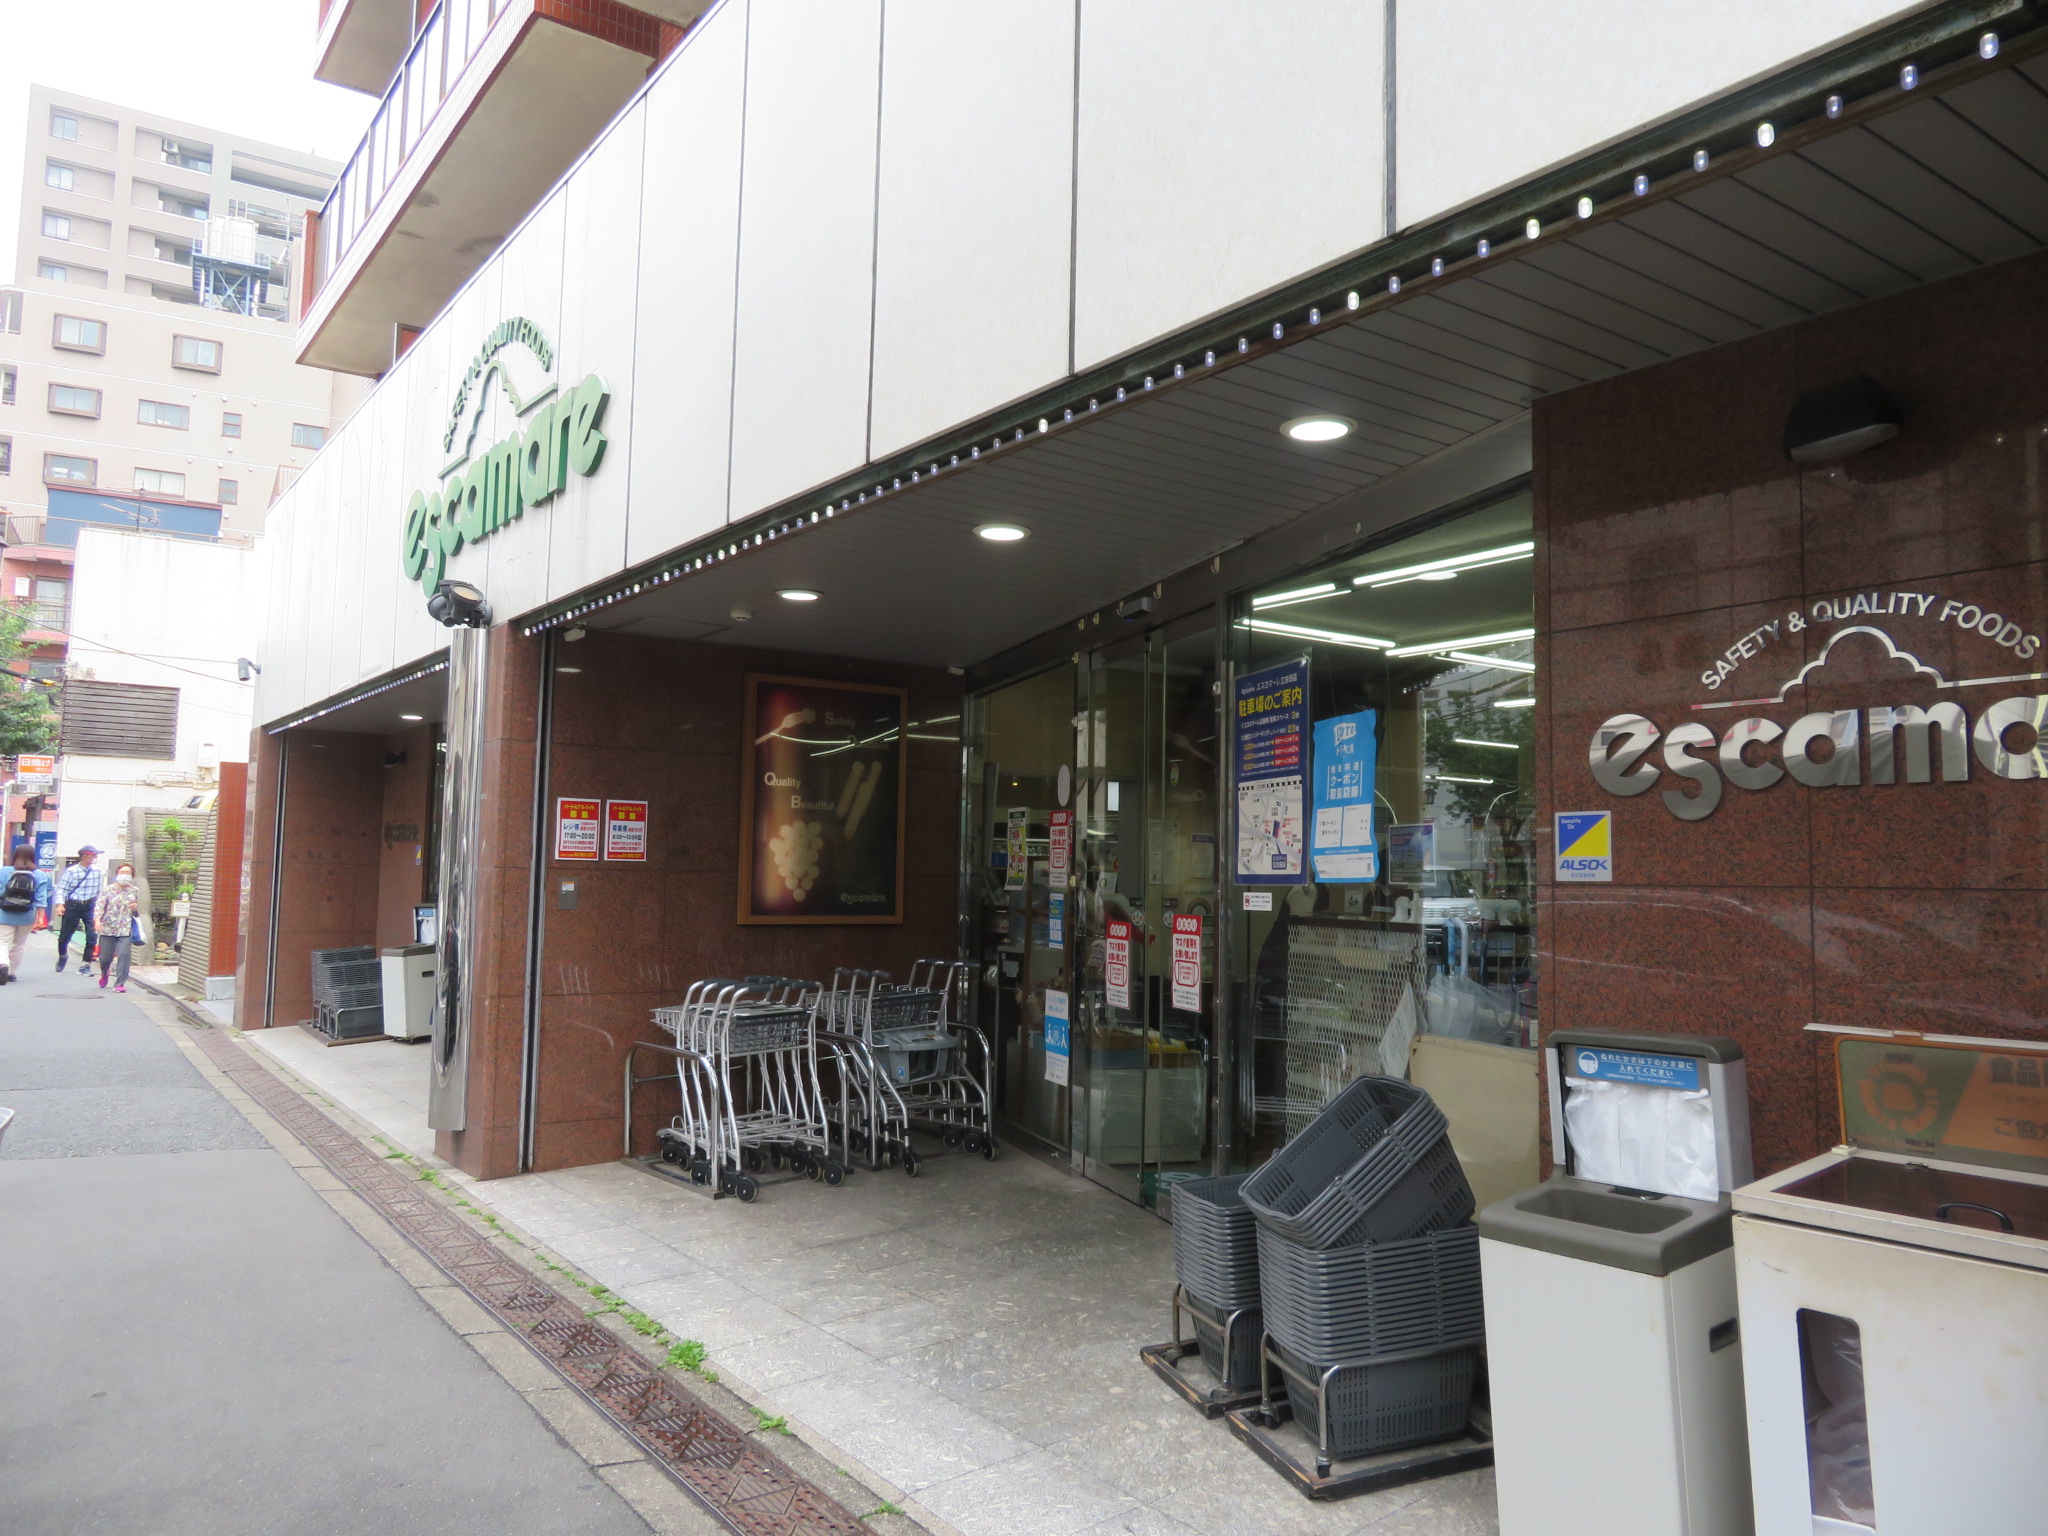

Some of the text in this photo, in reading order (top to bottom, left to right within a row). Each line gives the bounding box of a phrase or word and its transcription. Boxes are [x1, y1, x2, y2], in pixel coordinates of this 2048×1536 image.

[481, 317, 523, 364] QUALITY
[520, 318, 554, 373] FOODS
[403, 374, 610, 598] escamare
[1701, 591, 2041, 690] SAFETY & QUALITY FOODS
[1239, 687, 1303, 717] 駐車場のご案内
[824, 711, 856, 729] Safety
[764, 772, 801, 790] Quality
[1330, 773, 1359, 787] クーポン
[1329, 785, 1359, 801] 取扱店舗
[791, 795, 835, 810] Beautiful
[1560, 859, 1608, 871] ALSOK
[840, 892, 886, 905] escamare
[1619, 1064, 1674, 1077] 入れてください
[1989, 1056, 2048, 1088] 食品
